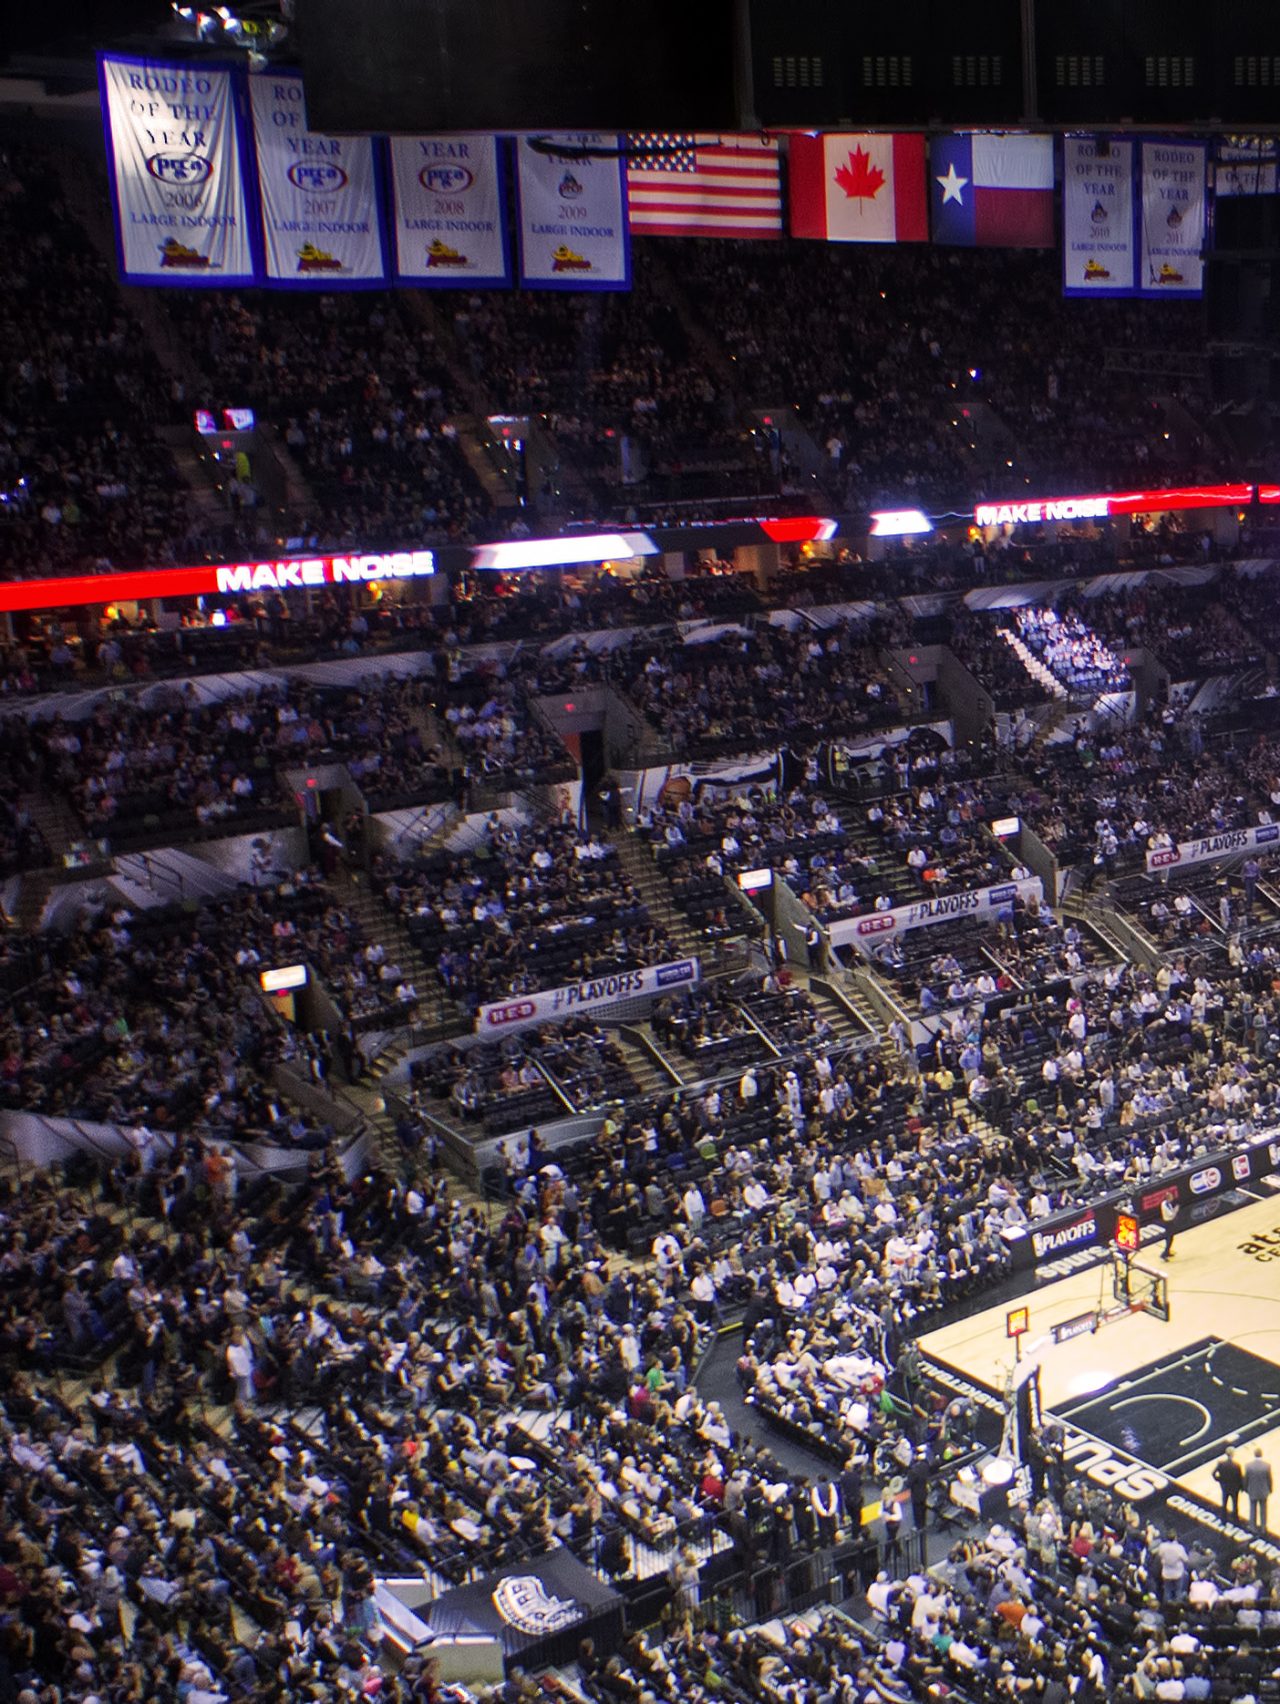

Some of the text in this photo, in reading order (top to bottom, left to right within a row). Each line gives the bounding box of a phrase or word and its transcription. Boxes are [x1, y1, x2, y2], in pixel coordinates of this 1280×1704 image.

[129, 72, 211, 95] RODEO
[167, 103, 217, 121] THE
[272, 112, 300, 128] OF
[145, 128, 207, 147] YEAR
[286, 137, 342, 155] YEAR
[419, 142, 470, 159] YEAR
[1153, 150, 1195, 163] RODEO
[1076, 164, 1122, 177] OF THE
[1152, 168, 1195, 182] OF THE
[1083, 183, 1116, 196] YEAR
[1159, 188, 1189, 200] YEAR
[305, 200, 336, 214] 2007
[434, 200, 465, 215] 2008
[557, 205, 588, 220] 2009
[130, 211, 237, 228] LARGE INDOOR
[318, 222, 369, 234] INDOOR
[404, 219, 494, 232] LARGE INDOOR
[531, 224, 614, 238] LARGE INDOOR
[976, 499, 1109, 526] MAKE NOISE
[216, 551, 435, 593] MAKE NOISE
[1200, 831, 1248, 854] PLAYOFFS
[919, 891, 979, 919] PLAYOFFS
[567, 971, 644, 1005] PLAYOFFS
[1043, 1220, 1096, 1250] PLAYOFFS
[1166, 1495, 1253, 1542] ANTONIO
